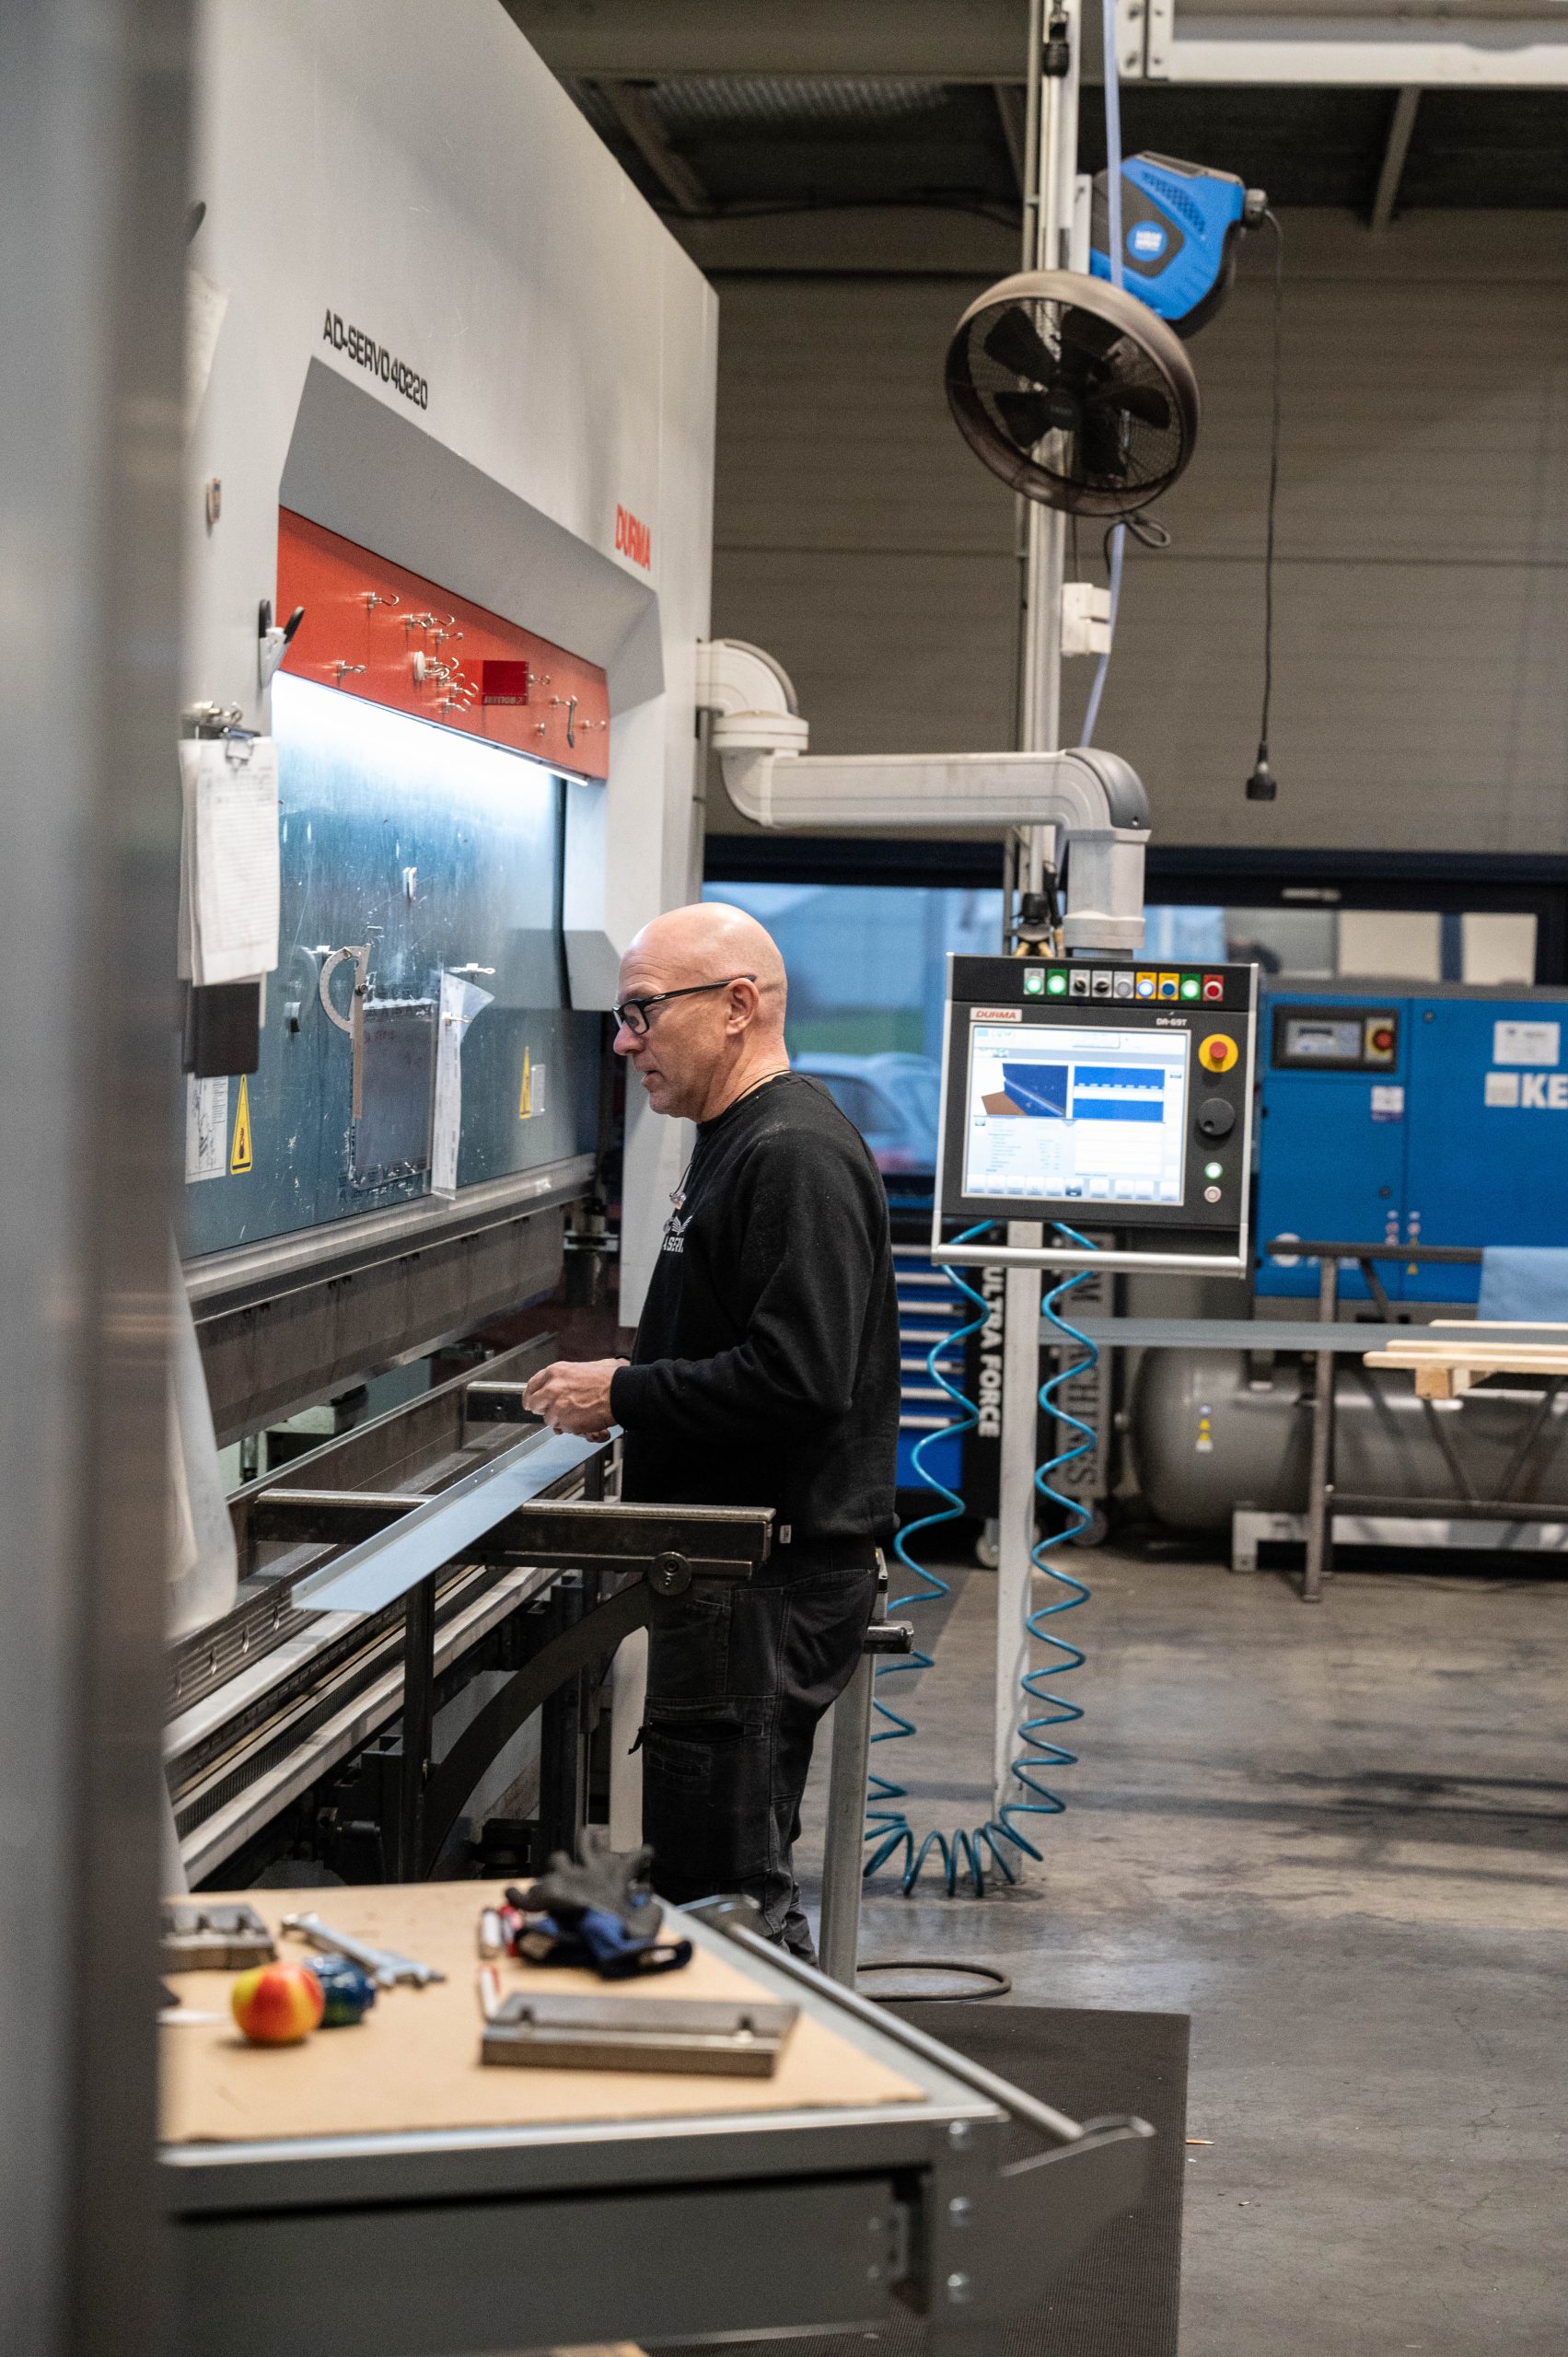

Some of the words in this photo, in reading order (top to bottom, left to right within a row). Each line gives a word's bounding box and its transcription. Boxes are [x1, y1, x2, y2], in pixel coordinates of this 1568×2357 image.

[391, 357, 428, 411] 40220
[615, 503, 651, 572] DURMA
[976, 1010, 1016, 1019] DURMA
[981, 1266, 1005, 1349] ULTRA
[978, 1353, 1003, 1438] FORCE
